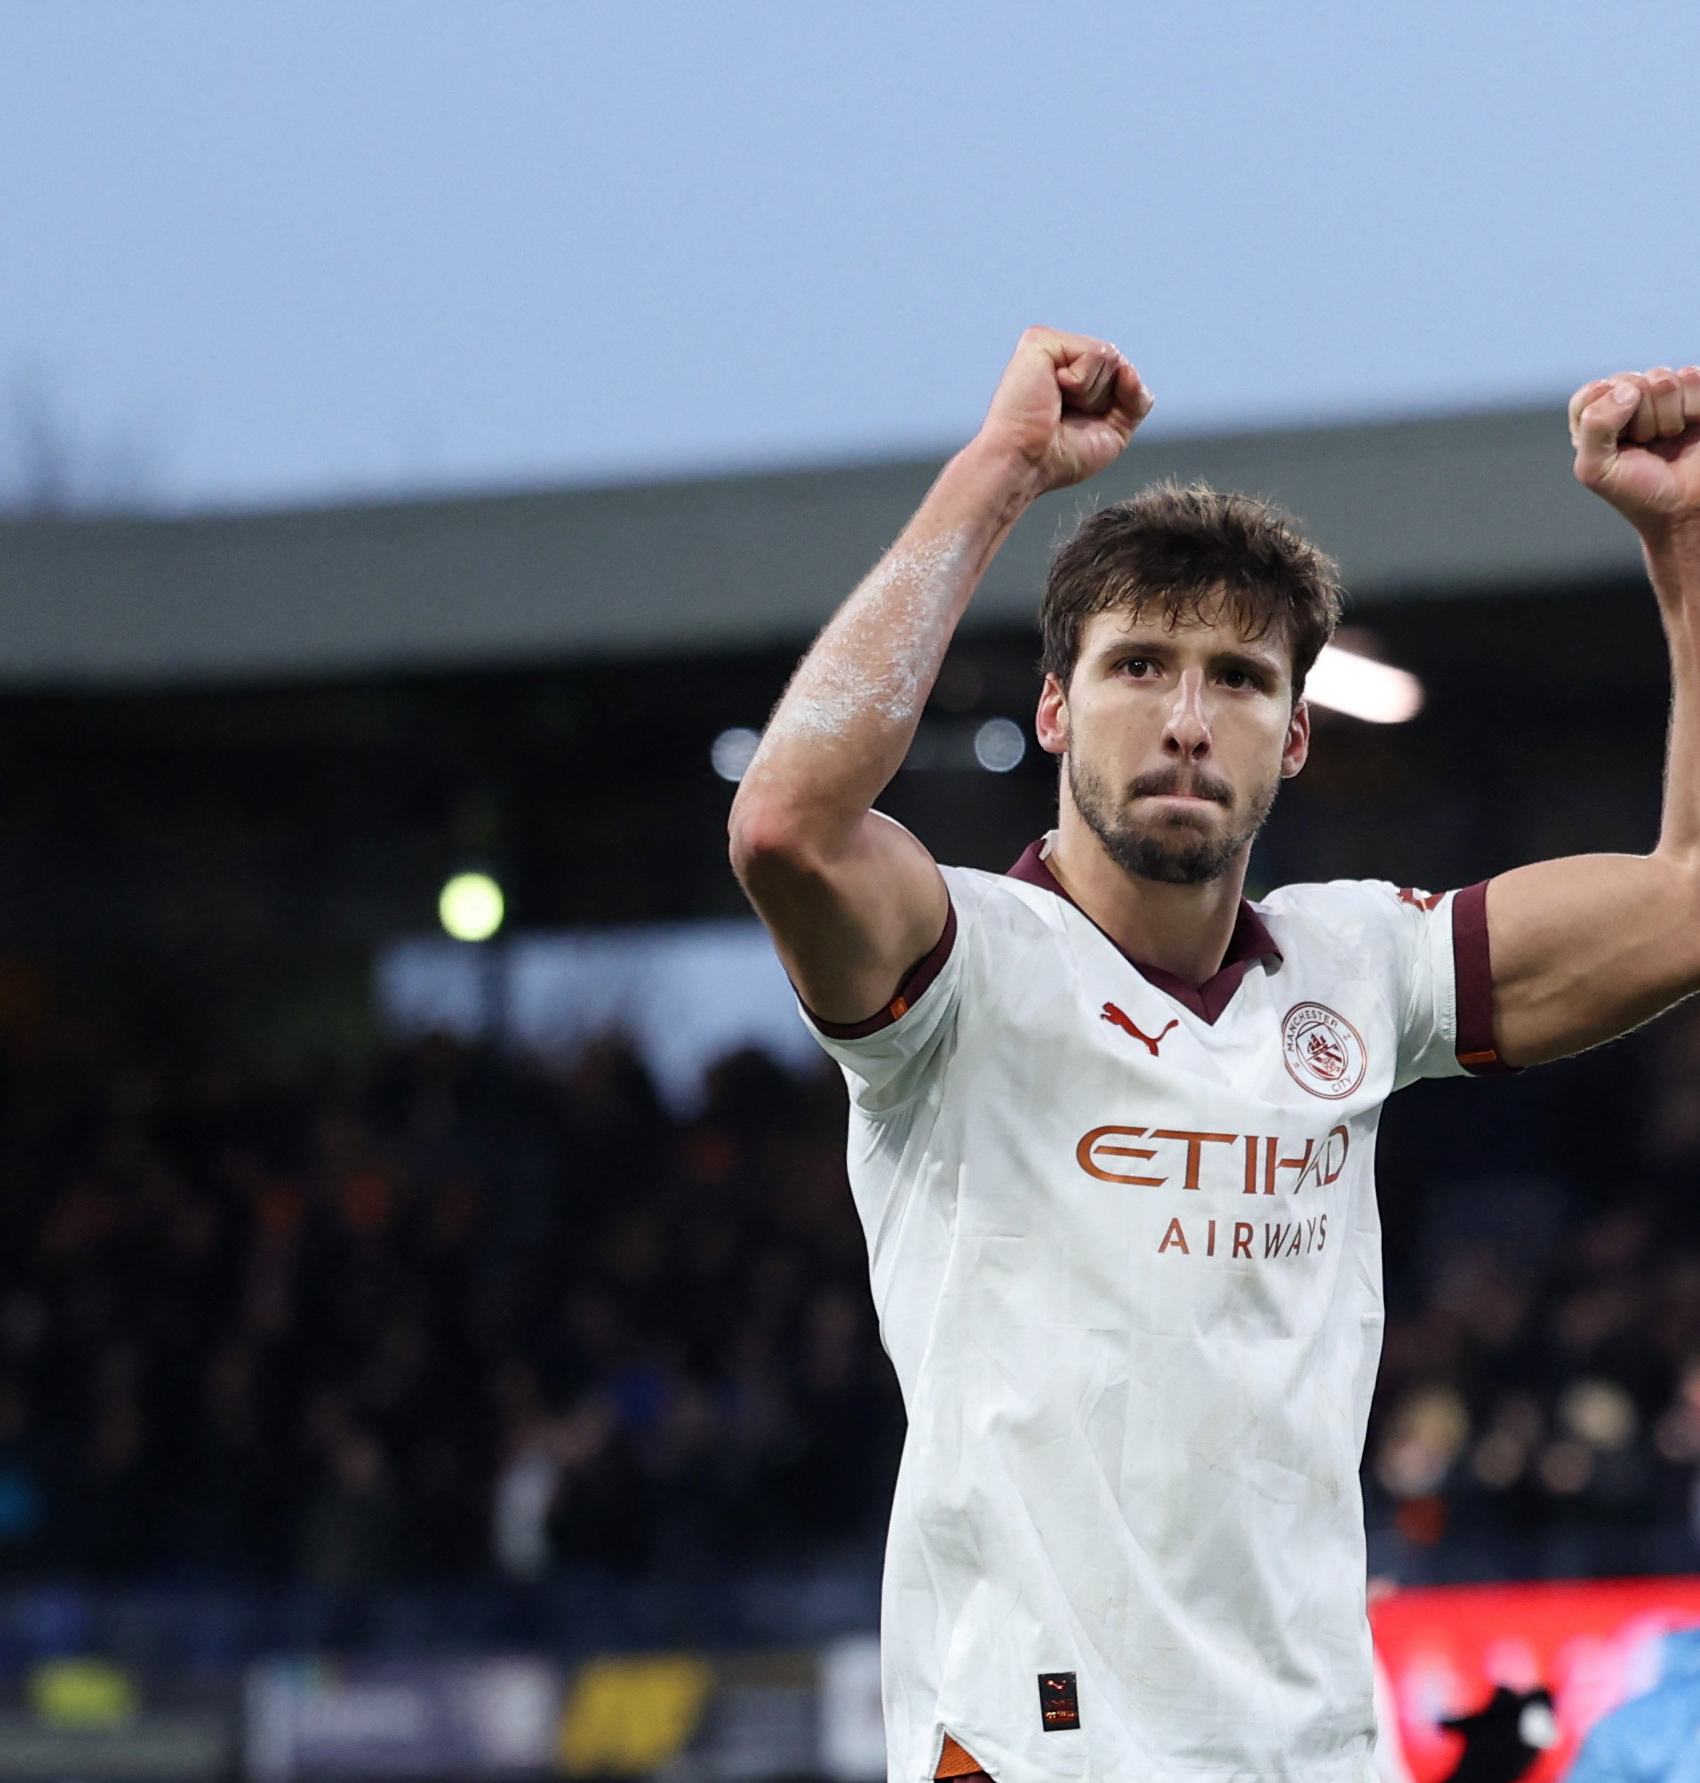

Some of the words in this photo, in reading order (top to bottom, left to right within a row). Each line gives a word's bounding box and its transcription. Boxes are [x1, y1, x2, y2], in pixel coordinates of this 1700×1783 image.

[1286, 1009, 1339, 1052] MANCHESTER
[1331, 1075, 1353, 1093] CITY
[1076, 1124, 1350, 1196] ETIHAD
[1156, 1213, 1329, 1260] AIRWAYS
